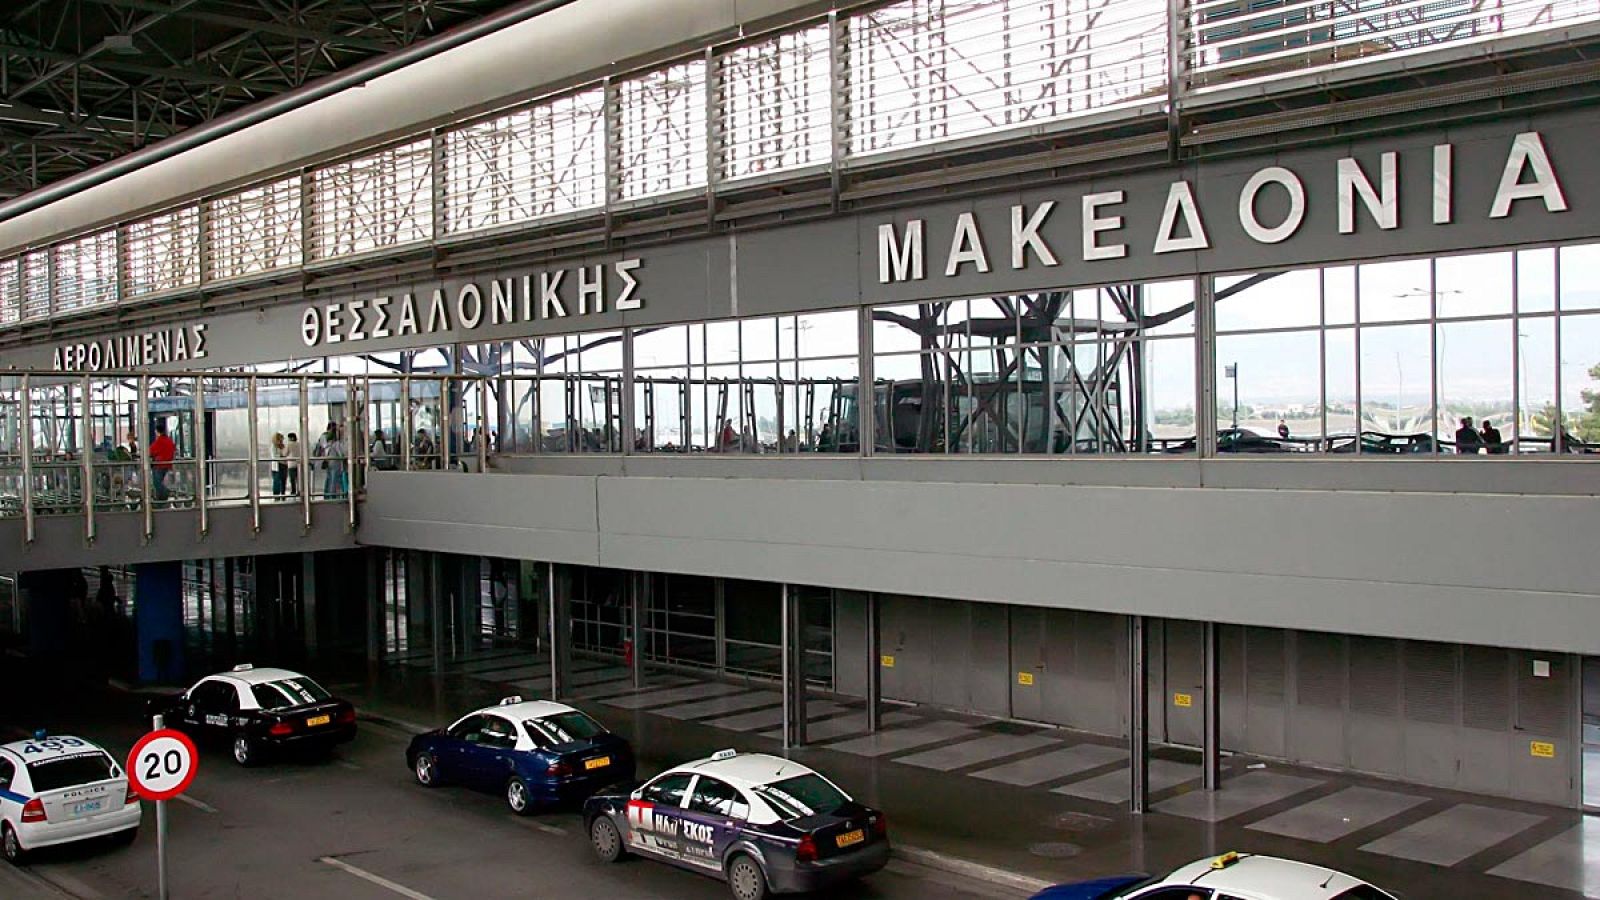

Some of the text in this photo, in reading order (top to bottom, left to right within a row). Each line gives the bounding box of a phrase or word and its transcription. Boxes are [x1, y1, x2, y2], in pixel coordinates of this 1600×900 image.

[53, 132, 1567, 371] ΑΕΡΟΛΙΜΕΝΑΣ ΘΕΣΣΑΛΟΝΙΚΗΣ ΜΑΚΕΔΟΝΙΑ
[144, 750, 182, 780] 20
